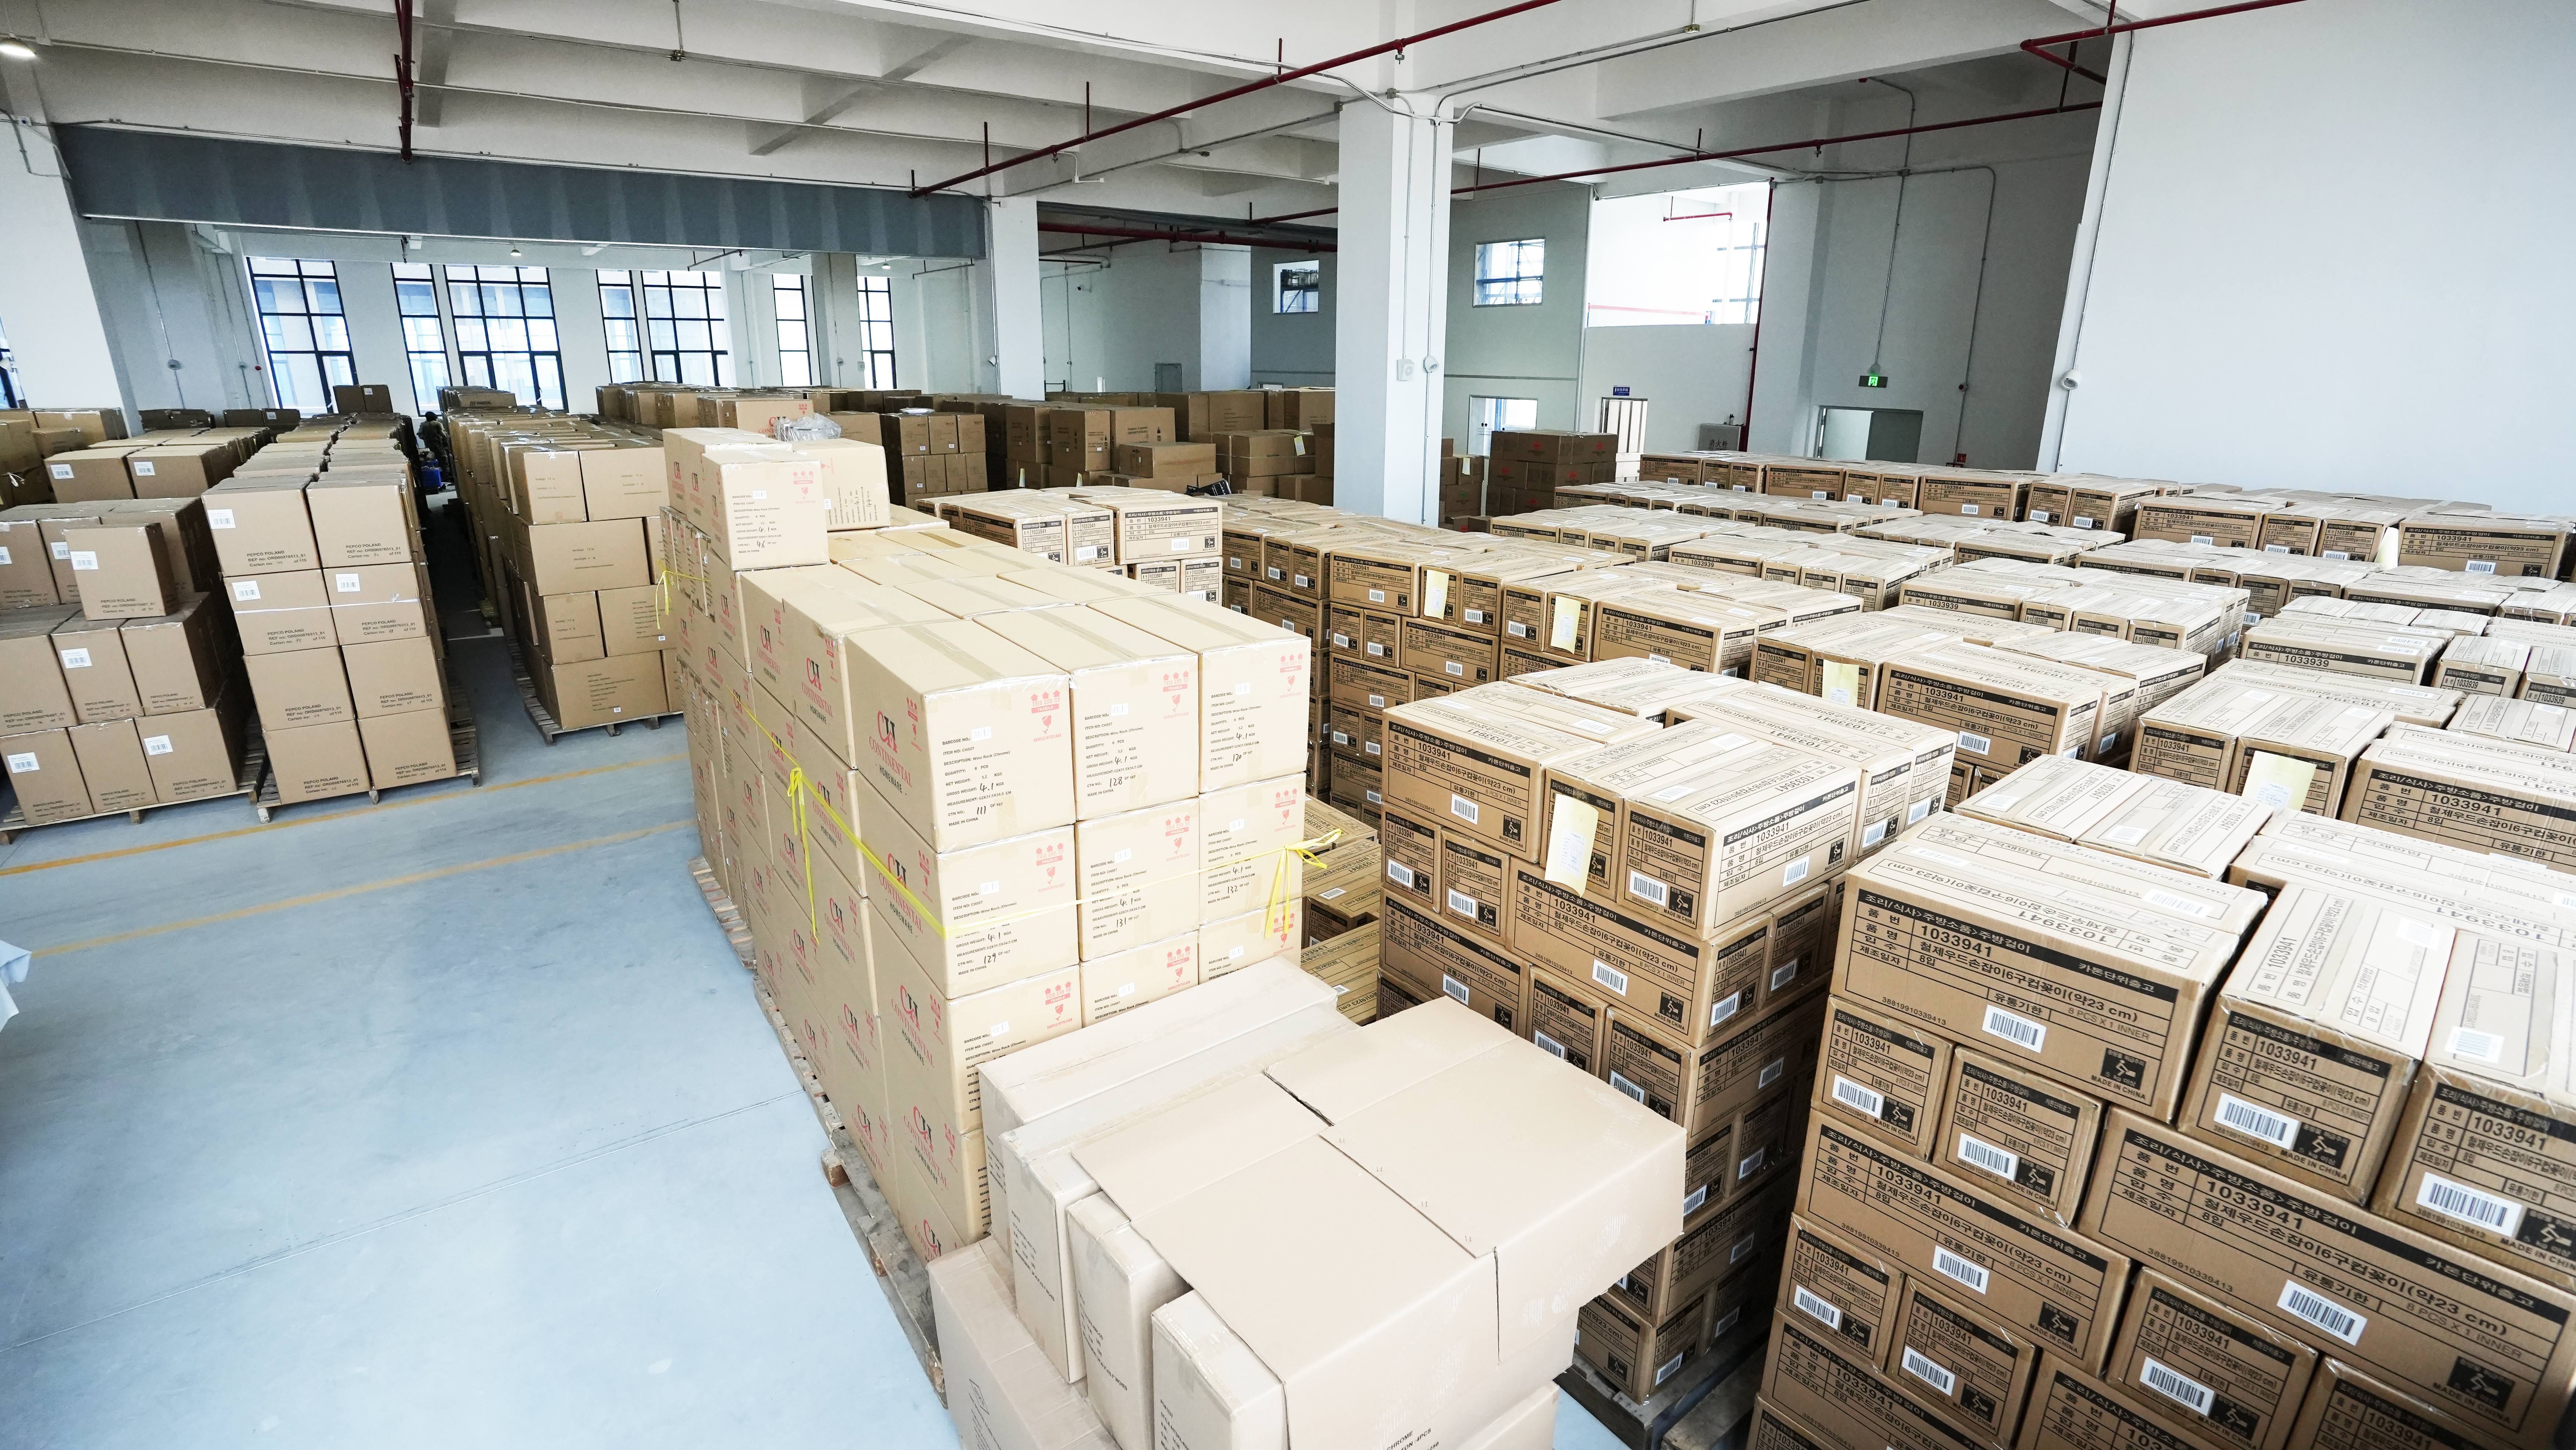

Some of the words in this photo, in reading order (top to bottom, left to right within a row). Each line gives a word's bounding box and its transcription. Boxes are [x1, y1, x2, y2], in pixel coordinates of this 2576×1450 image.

[1709, 439, 1728, 448] 消火栓
[756, 540, 766, 549] 46
[2285, 655, 2329, 667] 1033939
[869, 735, 912, 789] CONTINENTAL
[944, 757, 972, 766] DESCRIPTION:
[1418, 742, 1450, 760] 1033941
[879, 764, 902, 794] HOMEWARE
[979, 781, 994, 793] 4.1
[1110, 776, 1122, 788] 128
[947, 797, 978, 806] MEASUREMENT:
[2432, 794, 2501, 816] 1033941
[2368, 812, 2408, 825] 제조일자
[2427, 816, 2443, 825] 8입
[1756, 821, 1789, 844] 1033941
[1723, 873, 1745, 888] 제조일자
[1789, 844, 1808, 858] 유통기한
[1755, 856, 1763, 865] 8입
[1554, 897, 1596, 924] 1033941
[1554, 920, 1564, 930] 8입
[2018, 911, 2108, 941] 1033941
[1520, 912, 1544, 929] 제조일자
[1598, 950, 1625, 968] 유통기한
[1920, 924, 1993, 958] 1033941
[1860, 945, 1900, 965] 제조일자
[1994, 992, 2042, 1016] 유통기한
[2078, 962, 2155, 993] 카톤단위출고
[1919, 954, 1936, 967] 8입
[2077, 1009, 2097, 1022] PCS
[2117, 1024, 2150, 1041] INNER
[1882, 997, 1946, 1026] 38819910339413
[892, 999, 934, 1068] CONTINENTAL
[1854, 1031, 1891, 1054] 1033941
[902, 1029, 924, 1065] HOMEWARE
[2257, 1039, 2318, 1070] 1033941
[1985, 1086, 2028, 1112] 1033941
[2091, 1075, 2112, 1088] MADE
[2122, 1086, 2146, 1100] CHINA
[2205, 1179, 2304, 1231] 1033941
[2302, 1267, 2369, 1306] 유통기한
[1387, 1431, 1413, 1450] CHROME
